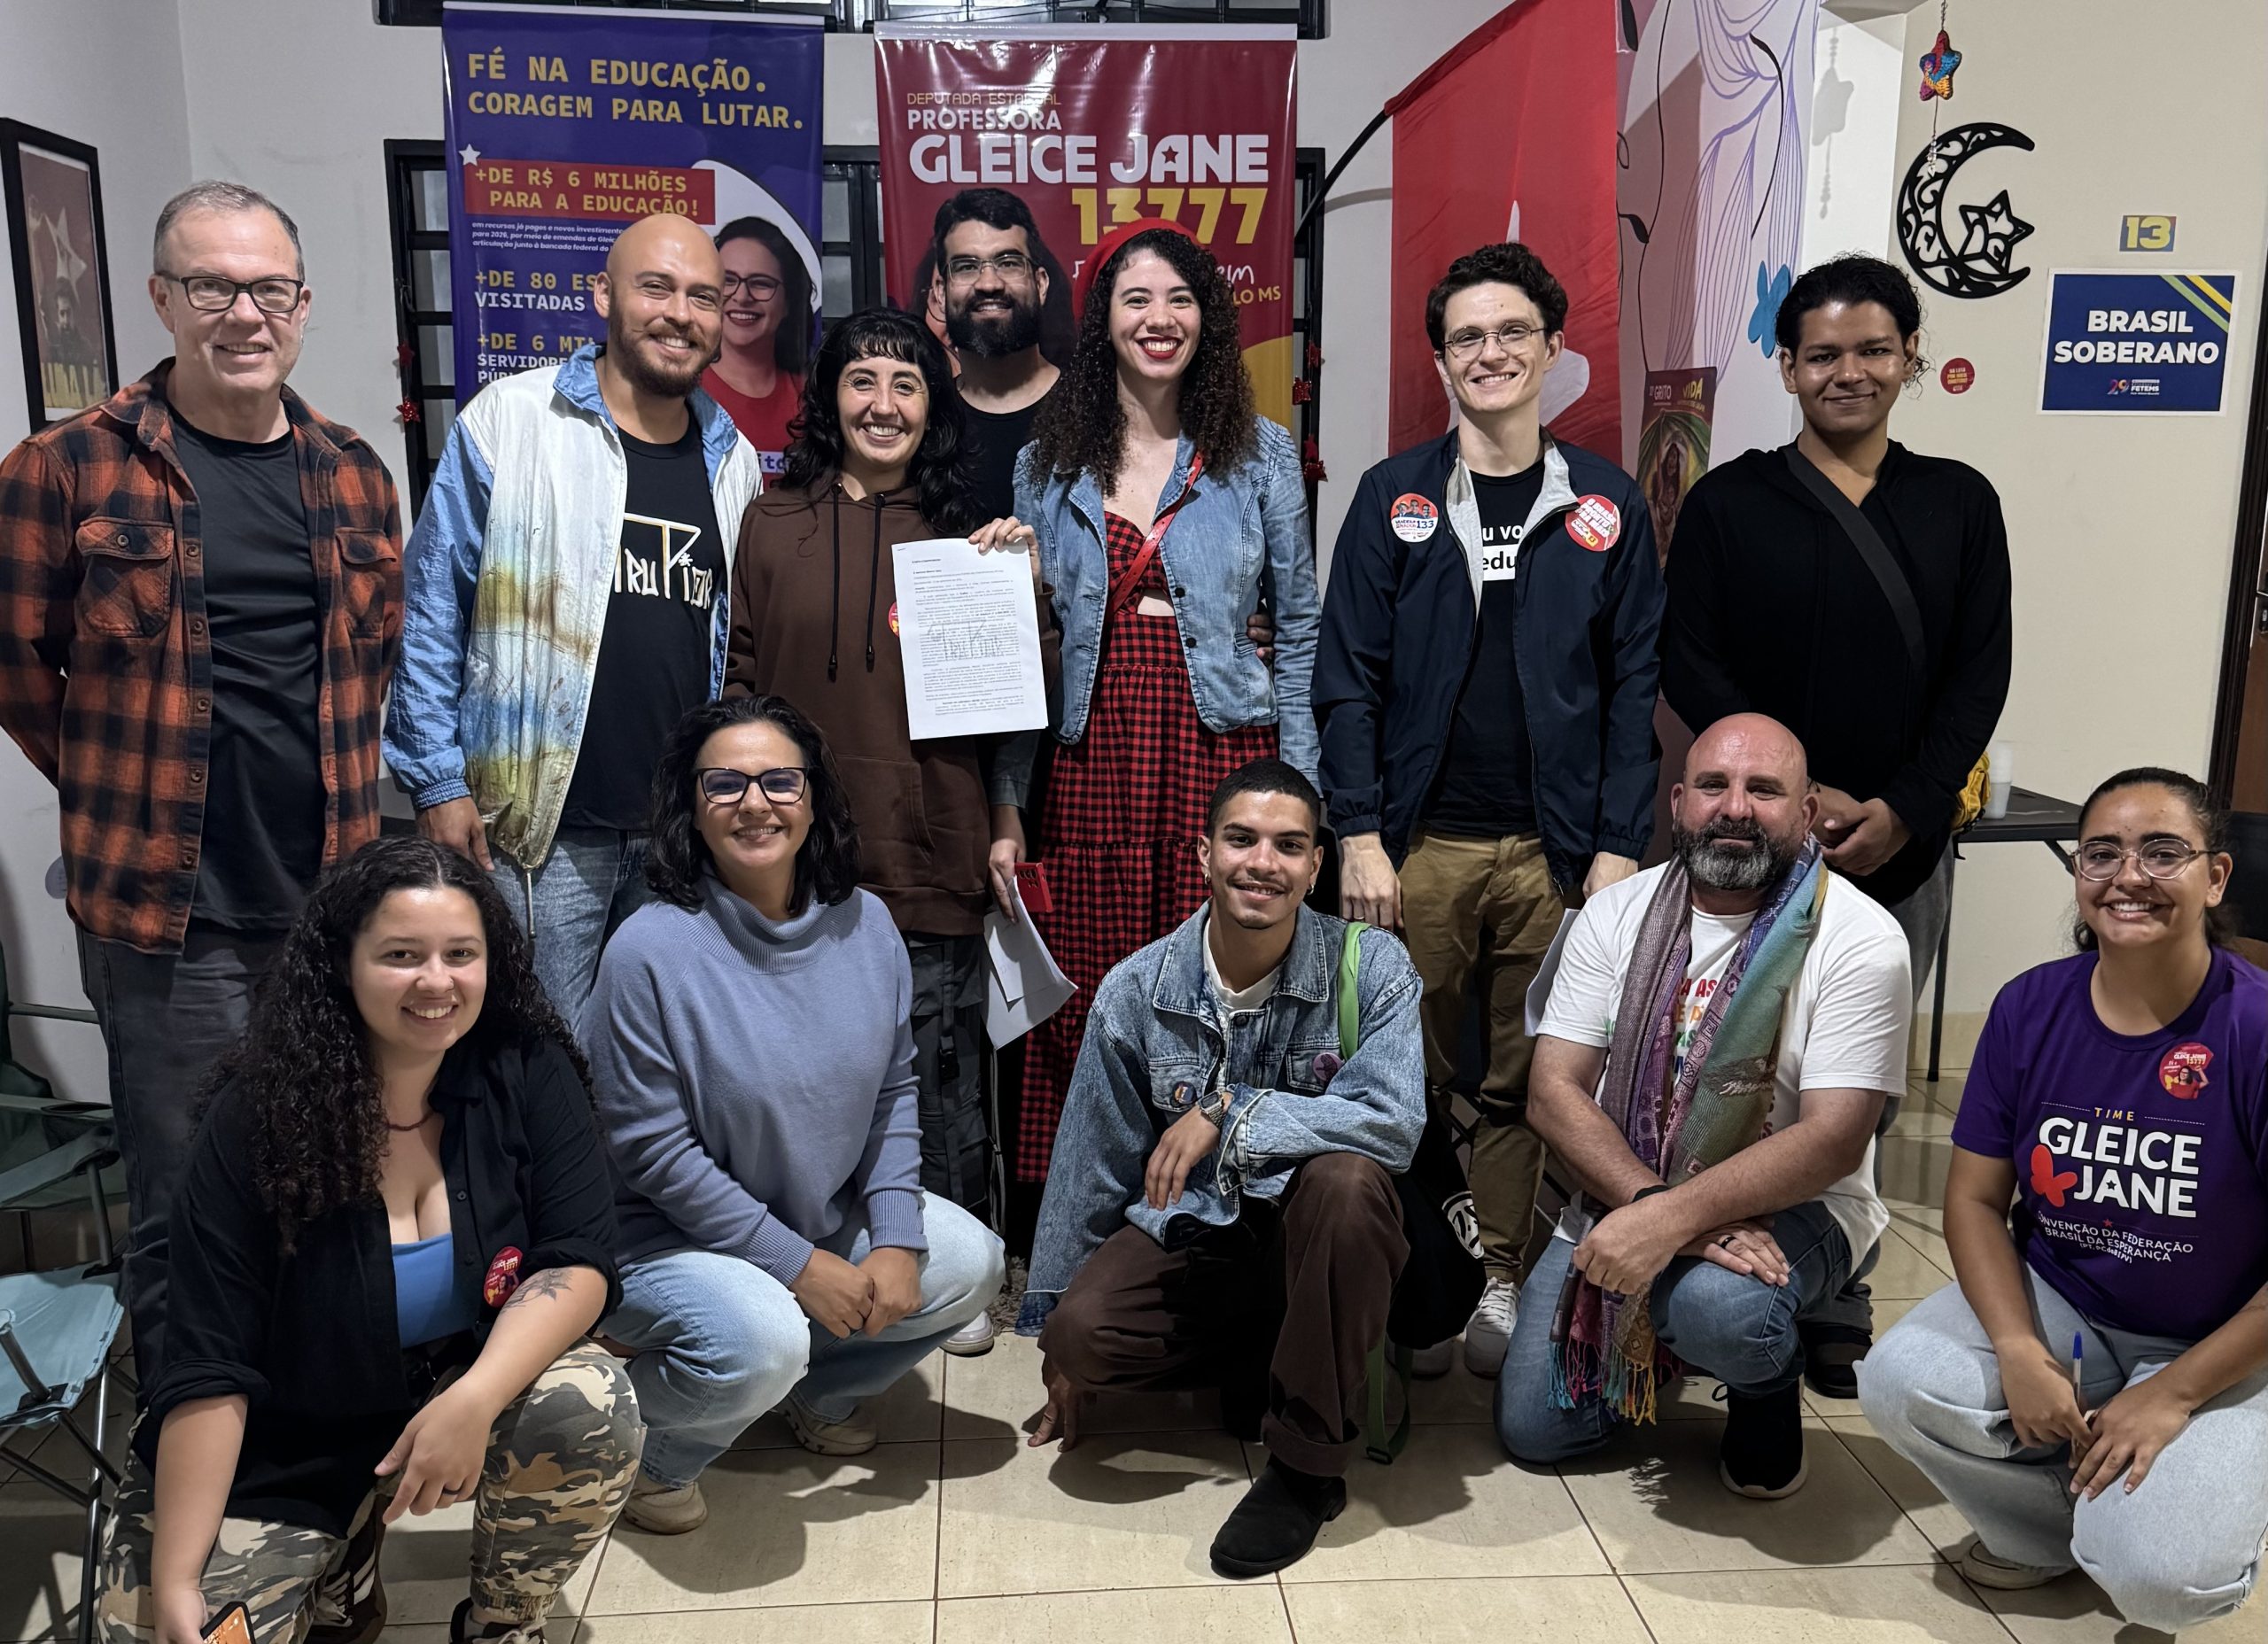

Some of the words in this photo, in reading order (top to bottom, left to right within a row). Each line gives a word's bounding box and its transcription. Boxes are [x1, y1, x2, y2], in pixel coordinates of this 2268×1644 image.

[468, 46, 506, 80] FÉ
[529, 56, 569, 83] NA
[590, 58, 766, 97] EDUCAÇÃO.
[468, 91, 593, 119] CORAGEM
[612, 98, 683, 123] PARA
[703, 104, 804, 129] LUTAR.
[906, 93, 982, 105] DEPUTADA
[989, 93, 1062, 105] ESTAAL
[907, 108, 1061, 130] PROFESSORA
[909, 135, 1097, 184] GLEICE
[1109, 135, 1269, 183] JANE
[476, 167, 514, 185] +DE
[528, 167, 553, 189] R$
[568, 171, 580, 187] 6
[594, 170, 687, 192] MILHÕES
[490, 190, 542, 209] PARA
[555, 193, 569, 210] A
[1071, 188, 1268, 244] 13777
[472, 239, 513, 248] articulação
[2125, 217, 2171, 250] 13
[476, 270, 515, 288] +DE
[530, 273, 556, 290] 80
[474, 291, 586, 312] VISITADAS
[1259, 286, 1281, 302] MS
[2087, 310, 2194, 334] BRASIL
[478, 332, 517, 351] +DE
[532, 335, 544, 352] 6
[2054, 340, 2219, 364] SOBERANO
[1654, 384, 1672, 400] GRITO
[1682, 377, 1704, 400] VIDA
[1417, 520, 1434, 529] 133
[2093, 1107, 2135, 1121] TIME
[2039, 1117, 2202, 1175] GLEICE
[2073, 1165, 2198, 1218] JANE
[2045, 1226, 2084, 1243] BRASIL
[2086, 1236, 2105, 1245] DA
[2107, 1238, 2171, 1262] ESPERANÇA
[2101, 1229, 2120, 1238] DA
[2123, 1231, 2194, 1253] FEDERAÇÃO
